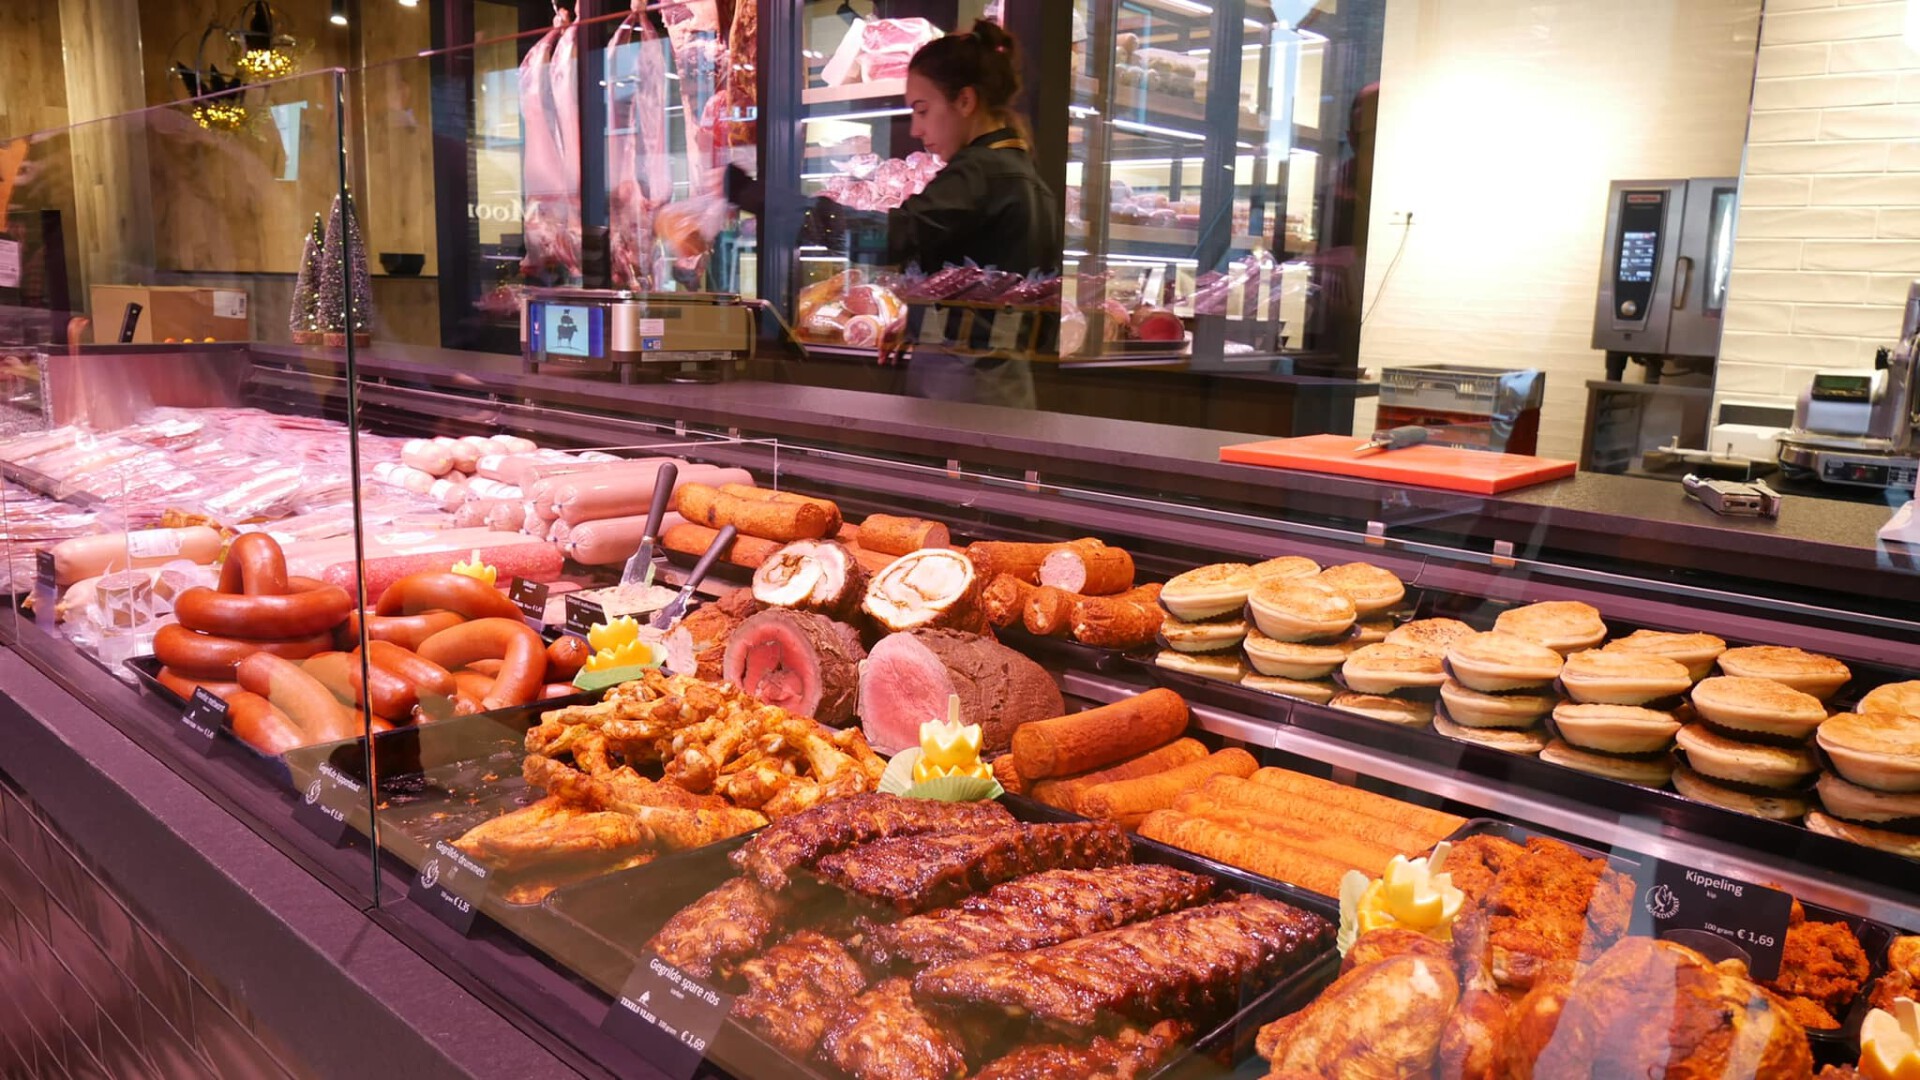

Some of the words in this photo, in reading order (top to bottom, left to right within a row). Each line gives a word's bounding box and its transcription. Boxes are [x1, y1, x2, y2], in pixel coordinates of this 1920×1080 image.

[436, 840, 459, 861] Gegrilde
[458, 854, 486, 878] drummets
[1685, 870, 1743, 897] Kippeling
[1706, 890, 1717, 899] kip
[1704, 922, 1716, 931] 100
[1716, 925, 1734, 936] gram
[1737, 928, 1746, 939] €
[1748, 931, 1774, 947] 1,69
[650, 958, 682, 983] Gegrilde
[681, 979, 704, 997] spare
[703, 990, 720, 1006] ribs
[686, 1034, 706, 1051] 1,69
